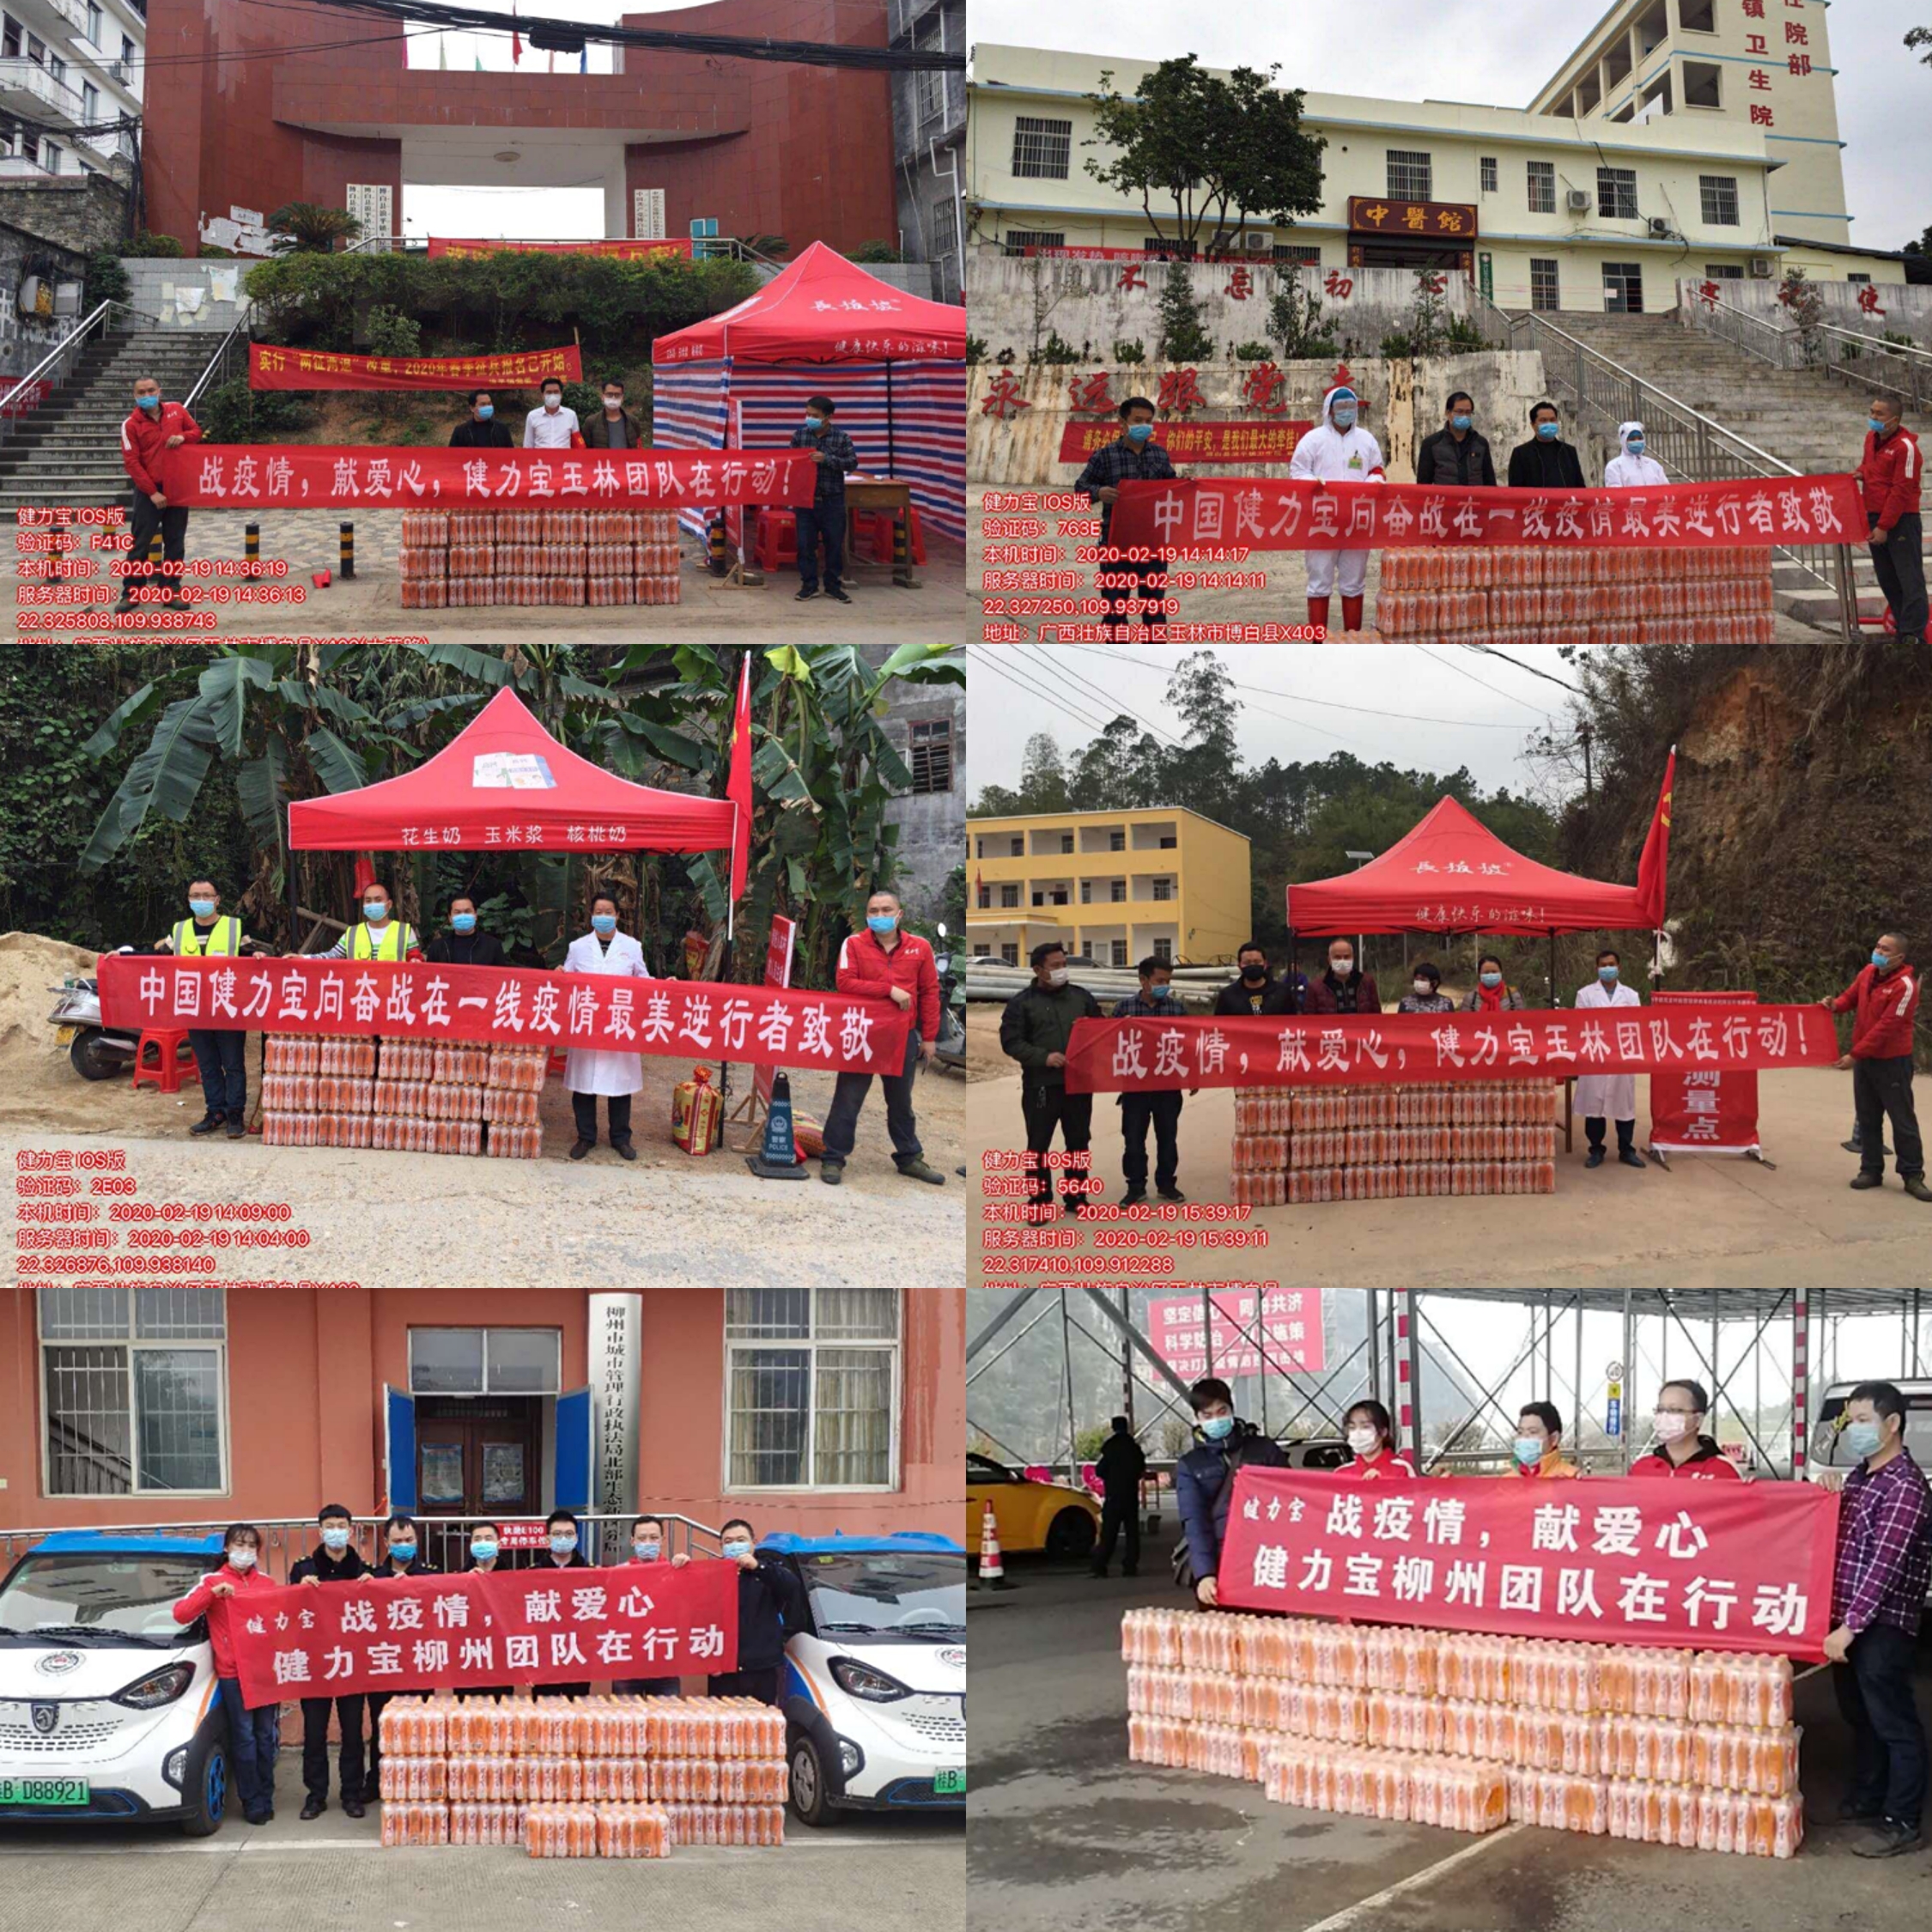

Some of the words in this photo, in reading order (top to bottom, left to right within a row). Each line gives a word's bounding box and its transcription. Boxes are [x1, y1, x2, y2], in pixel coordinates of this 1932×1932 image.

[1741, 0, 1774, 126] 镇卫生院
[1365, 204, 1463, 233] 中醫館
[199, 455, 793, 498] 战疫情，献爱心，健力宝玉林团队在行动！
[1154, 486, 1843, 543] 中国健力宝向奋战在一线疫情最美逆行者致敬
[402, 827, 461, 846] 花生奶
[484, 824, 544, 844] 玉米浆
[567, 825, 628, 843] 核桃奶
[139, 967, 874, 1062] 中国健力宝向奋战在一线疫情最美逆行者致敬
[1113, 1012, 1808, 1078] 战疫情，献爱心，健力宝玉林团队在行动！
[1242, 1496, 1307, 1523] 健力宝
[1253, 1544, 1807, 1636] 健力宝柳州团队在行动
[246, 1608, 316, 1635] 健力宝
[273, 1625, 725, 1685] 健力宝柳州团队在行动
